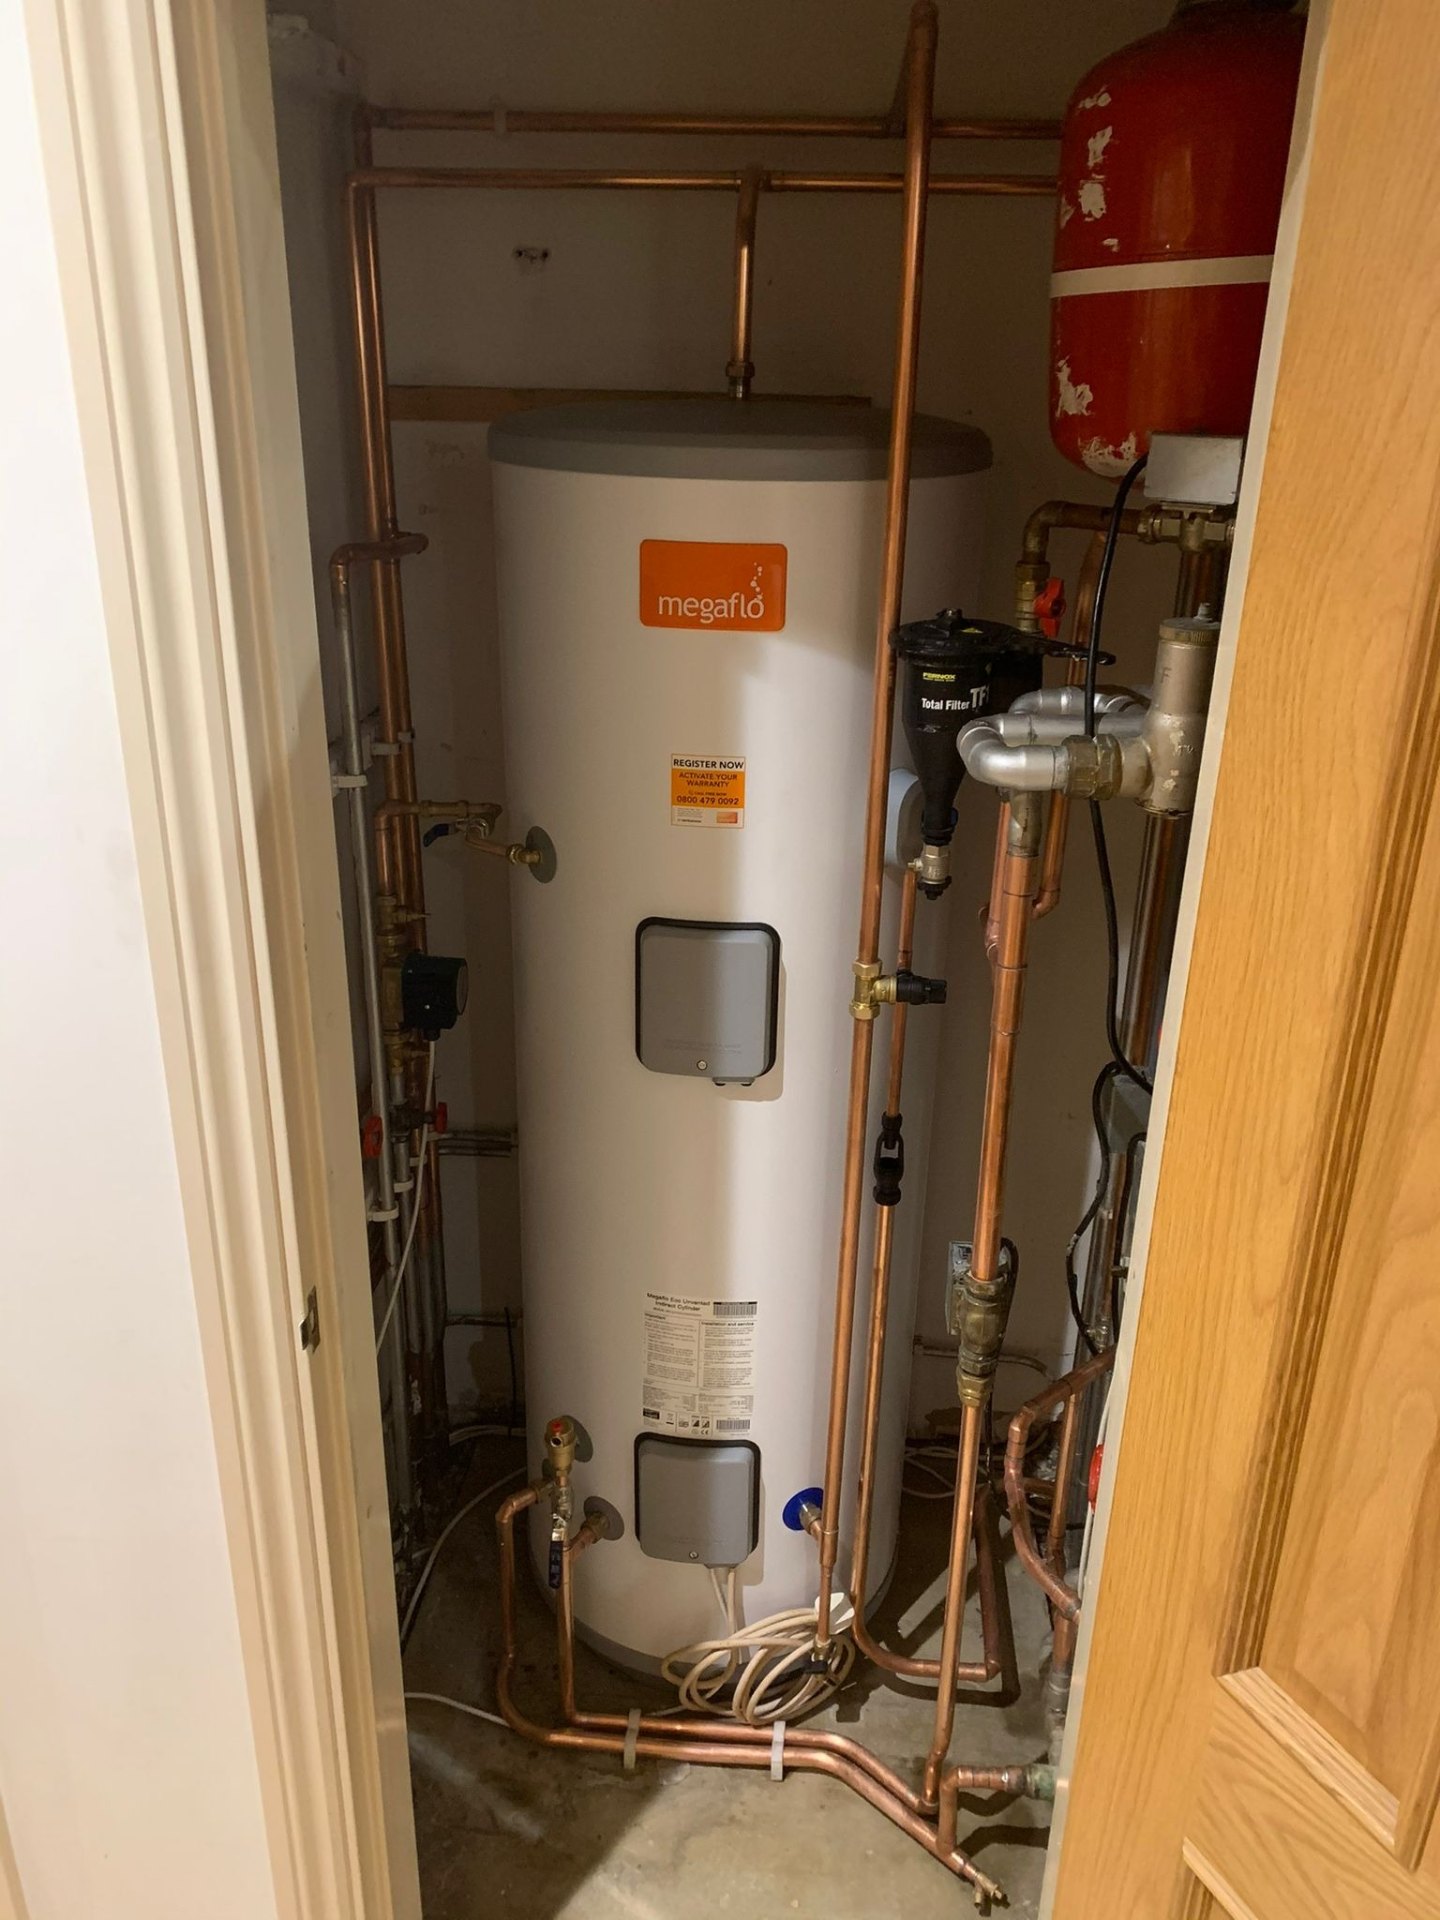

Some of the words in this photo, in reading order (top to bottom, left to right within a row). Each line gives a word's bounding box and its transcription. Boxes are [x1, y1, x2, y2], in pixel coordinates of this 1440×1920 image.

[658, 592, 765, 624] megaflo
[921, 697, 944, 710] Total
[945, 700, 970, 711] Filter
[673, 759, 717, 768] REGISTER
[719, 761, 743, 769] NOW
[679, 772, 714, 780] ACTIVATE
[676, 795, 698, 804] 0800
[718, 797, 739, 805] 0092
[677, 1303, 701, 1311] Cylinder
